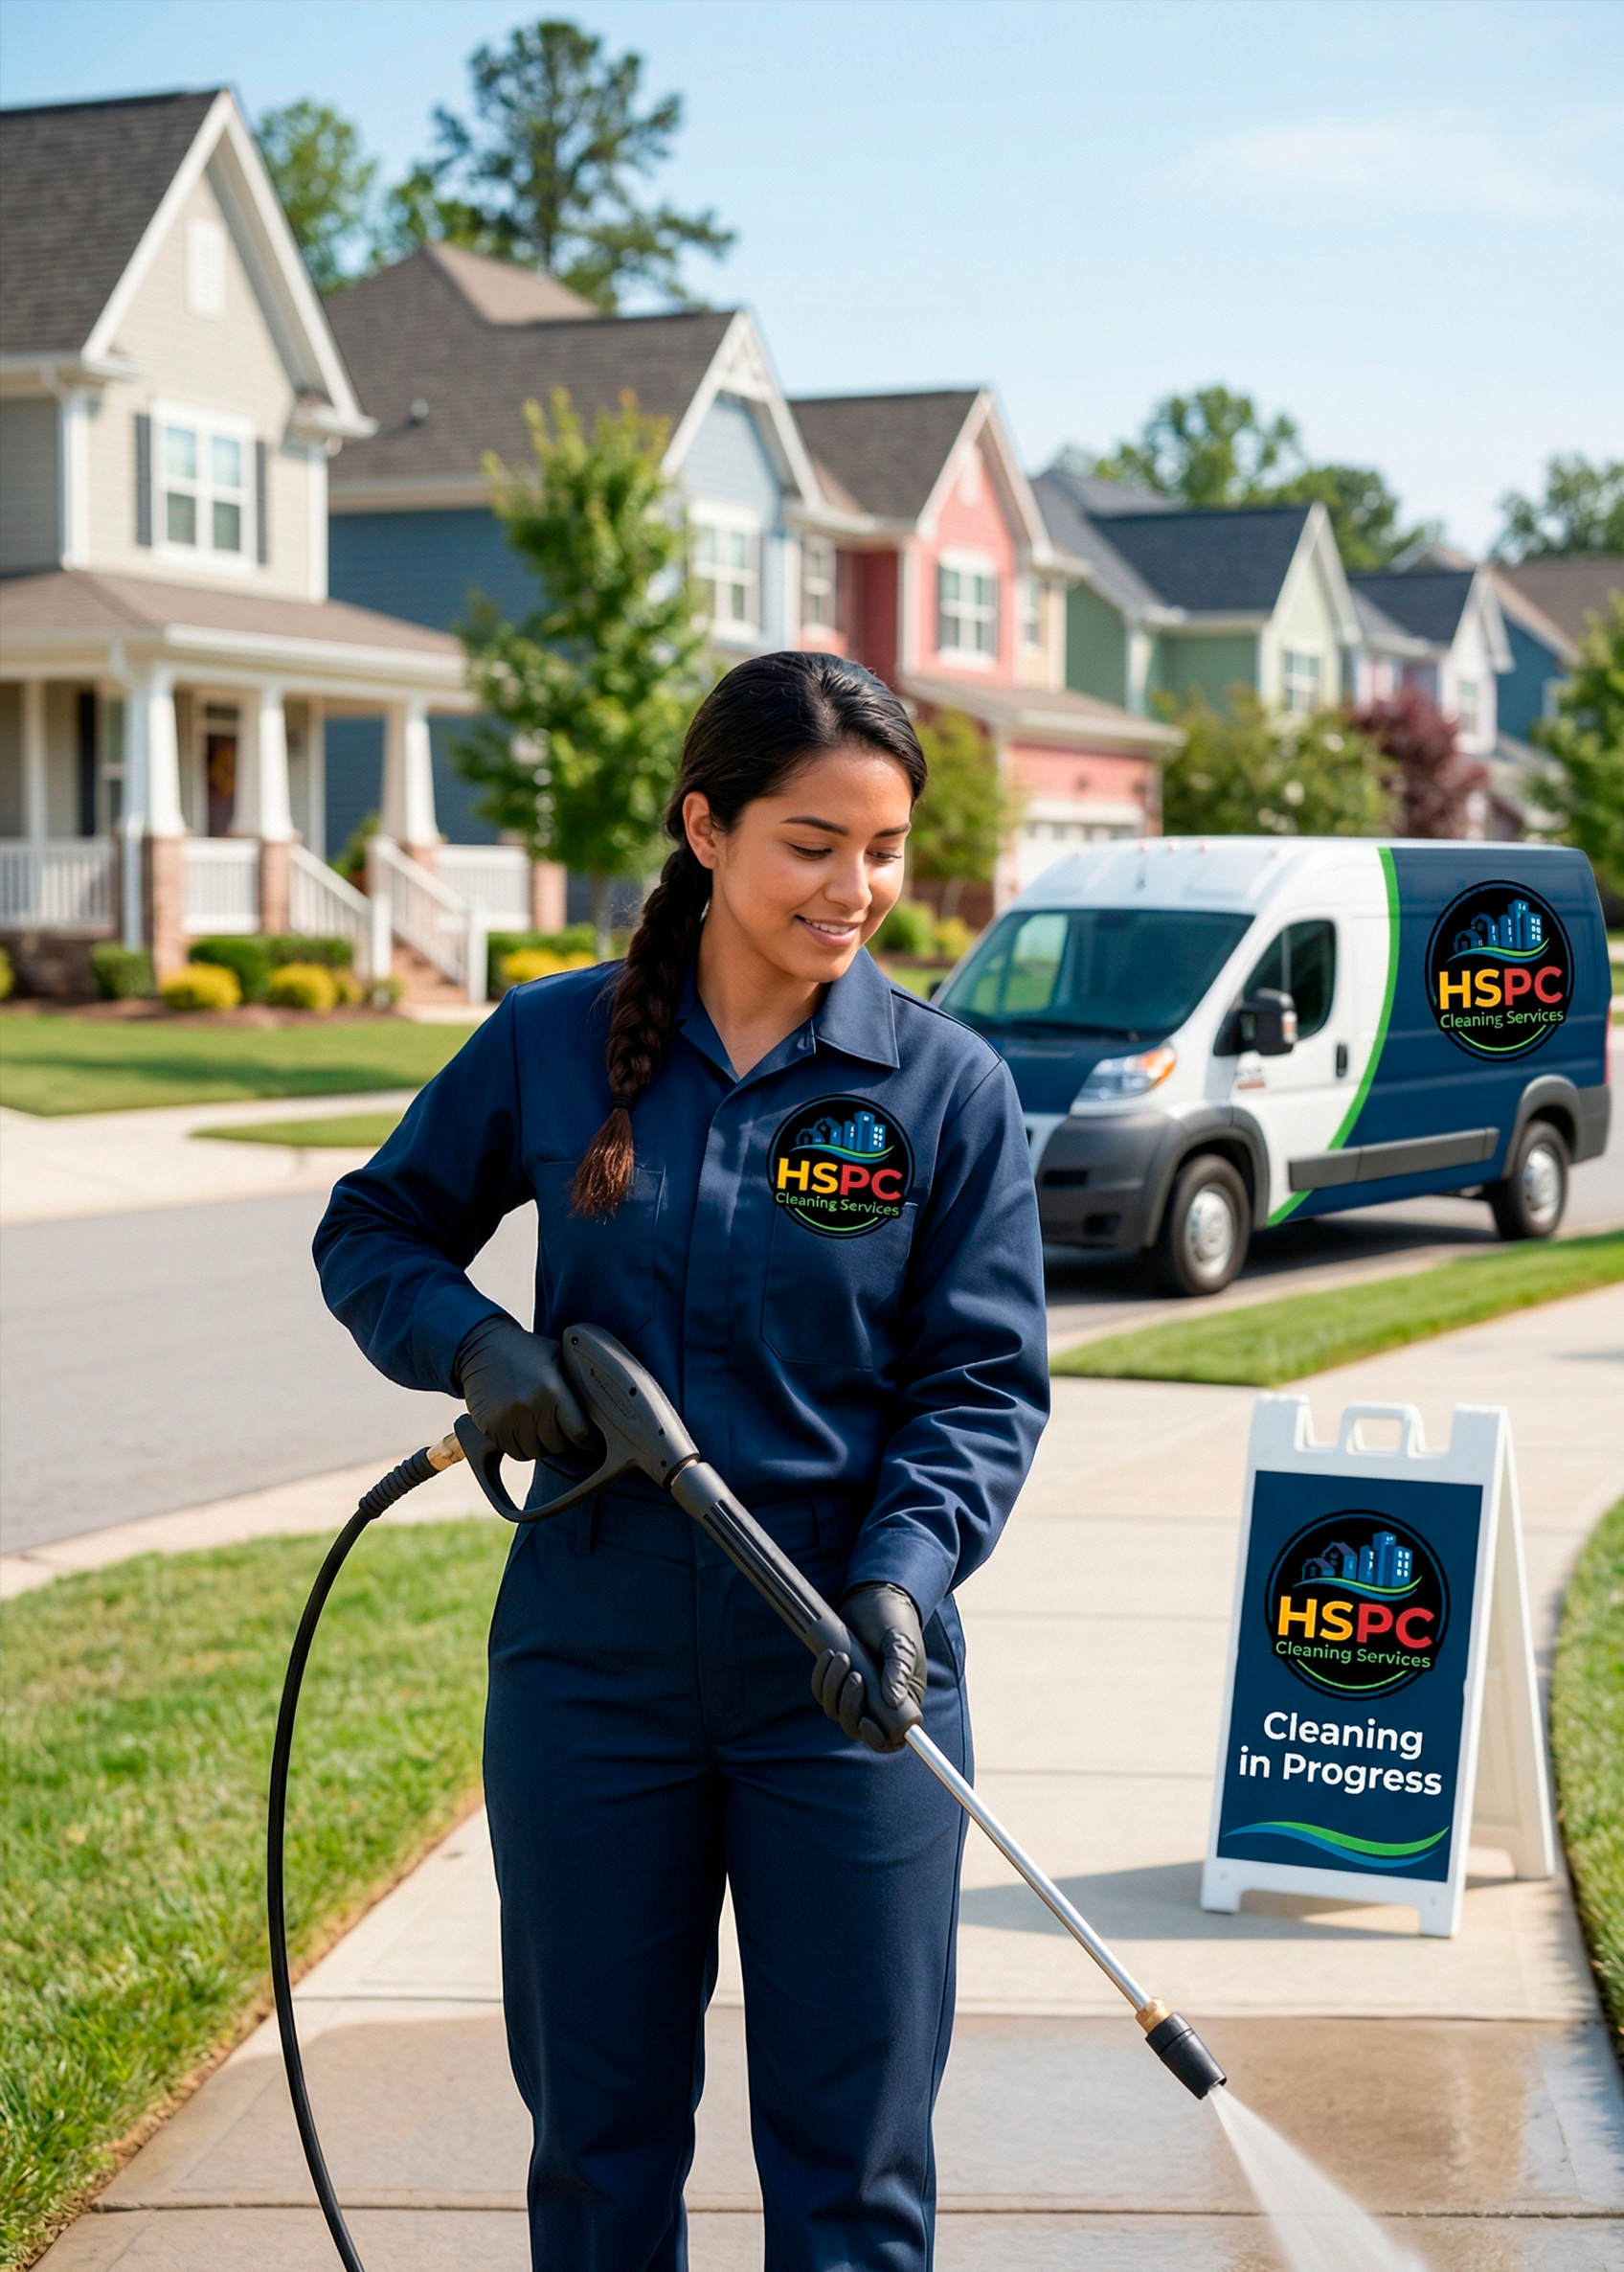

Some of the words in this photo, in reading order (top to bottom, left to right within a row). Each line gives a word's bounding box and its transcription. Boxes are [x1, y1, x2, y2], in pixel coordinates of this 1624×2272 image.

[1439, 966, 1563, 1010] HSPC
[1440, 1011, 1503, 1029] Cleaning
[1506, 1009, 1564, 1024] Services
[777, 1157, 903, 1200] HSPC
[776, 1192, 838, 1212] Cleaning
[840, 1198, 900, 1216] Services
[1277, 1596, 1434, 1648] HSPC
[1275, 1641, 1352, 1664] Cleaning
[1357, 1648, 1432, 1669] Services
[1264, 1712, 1423, 1760] Cleaning
[1239, 1745, 1271, 1778] in
[1283, 1753, 1442, 1795] Progress
